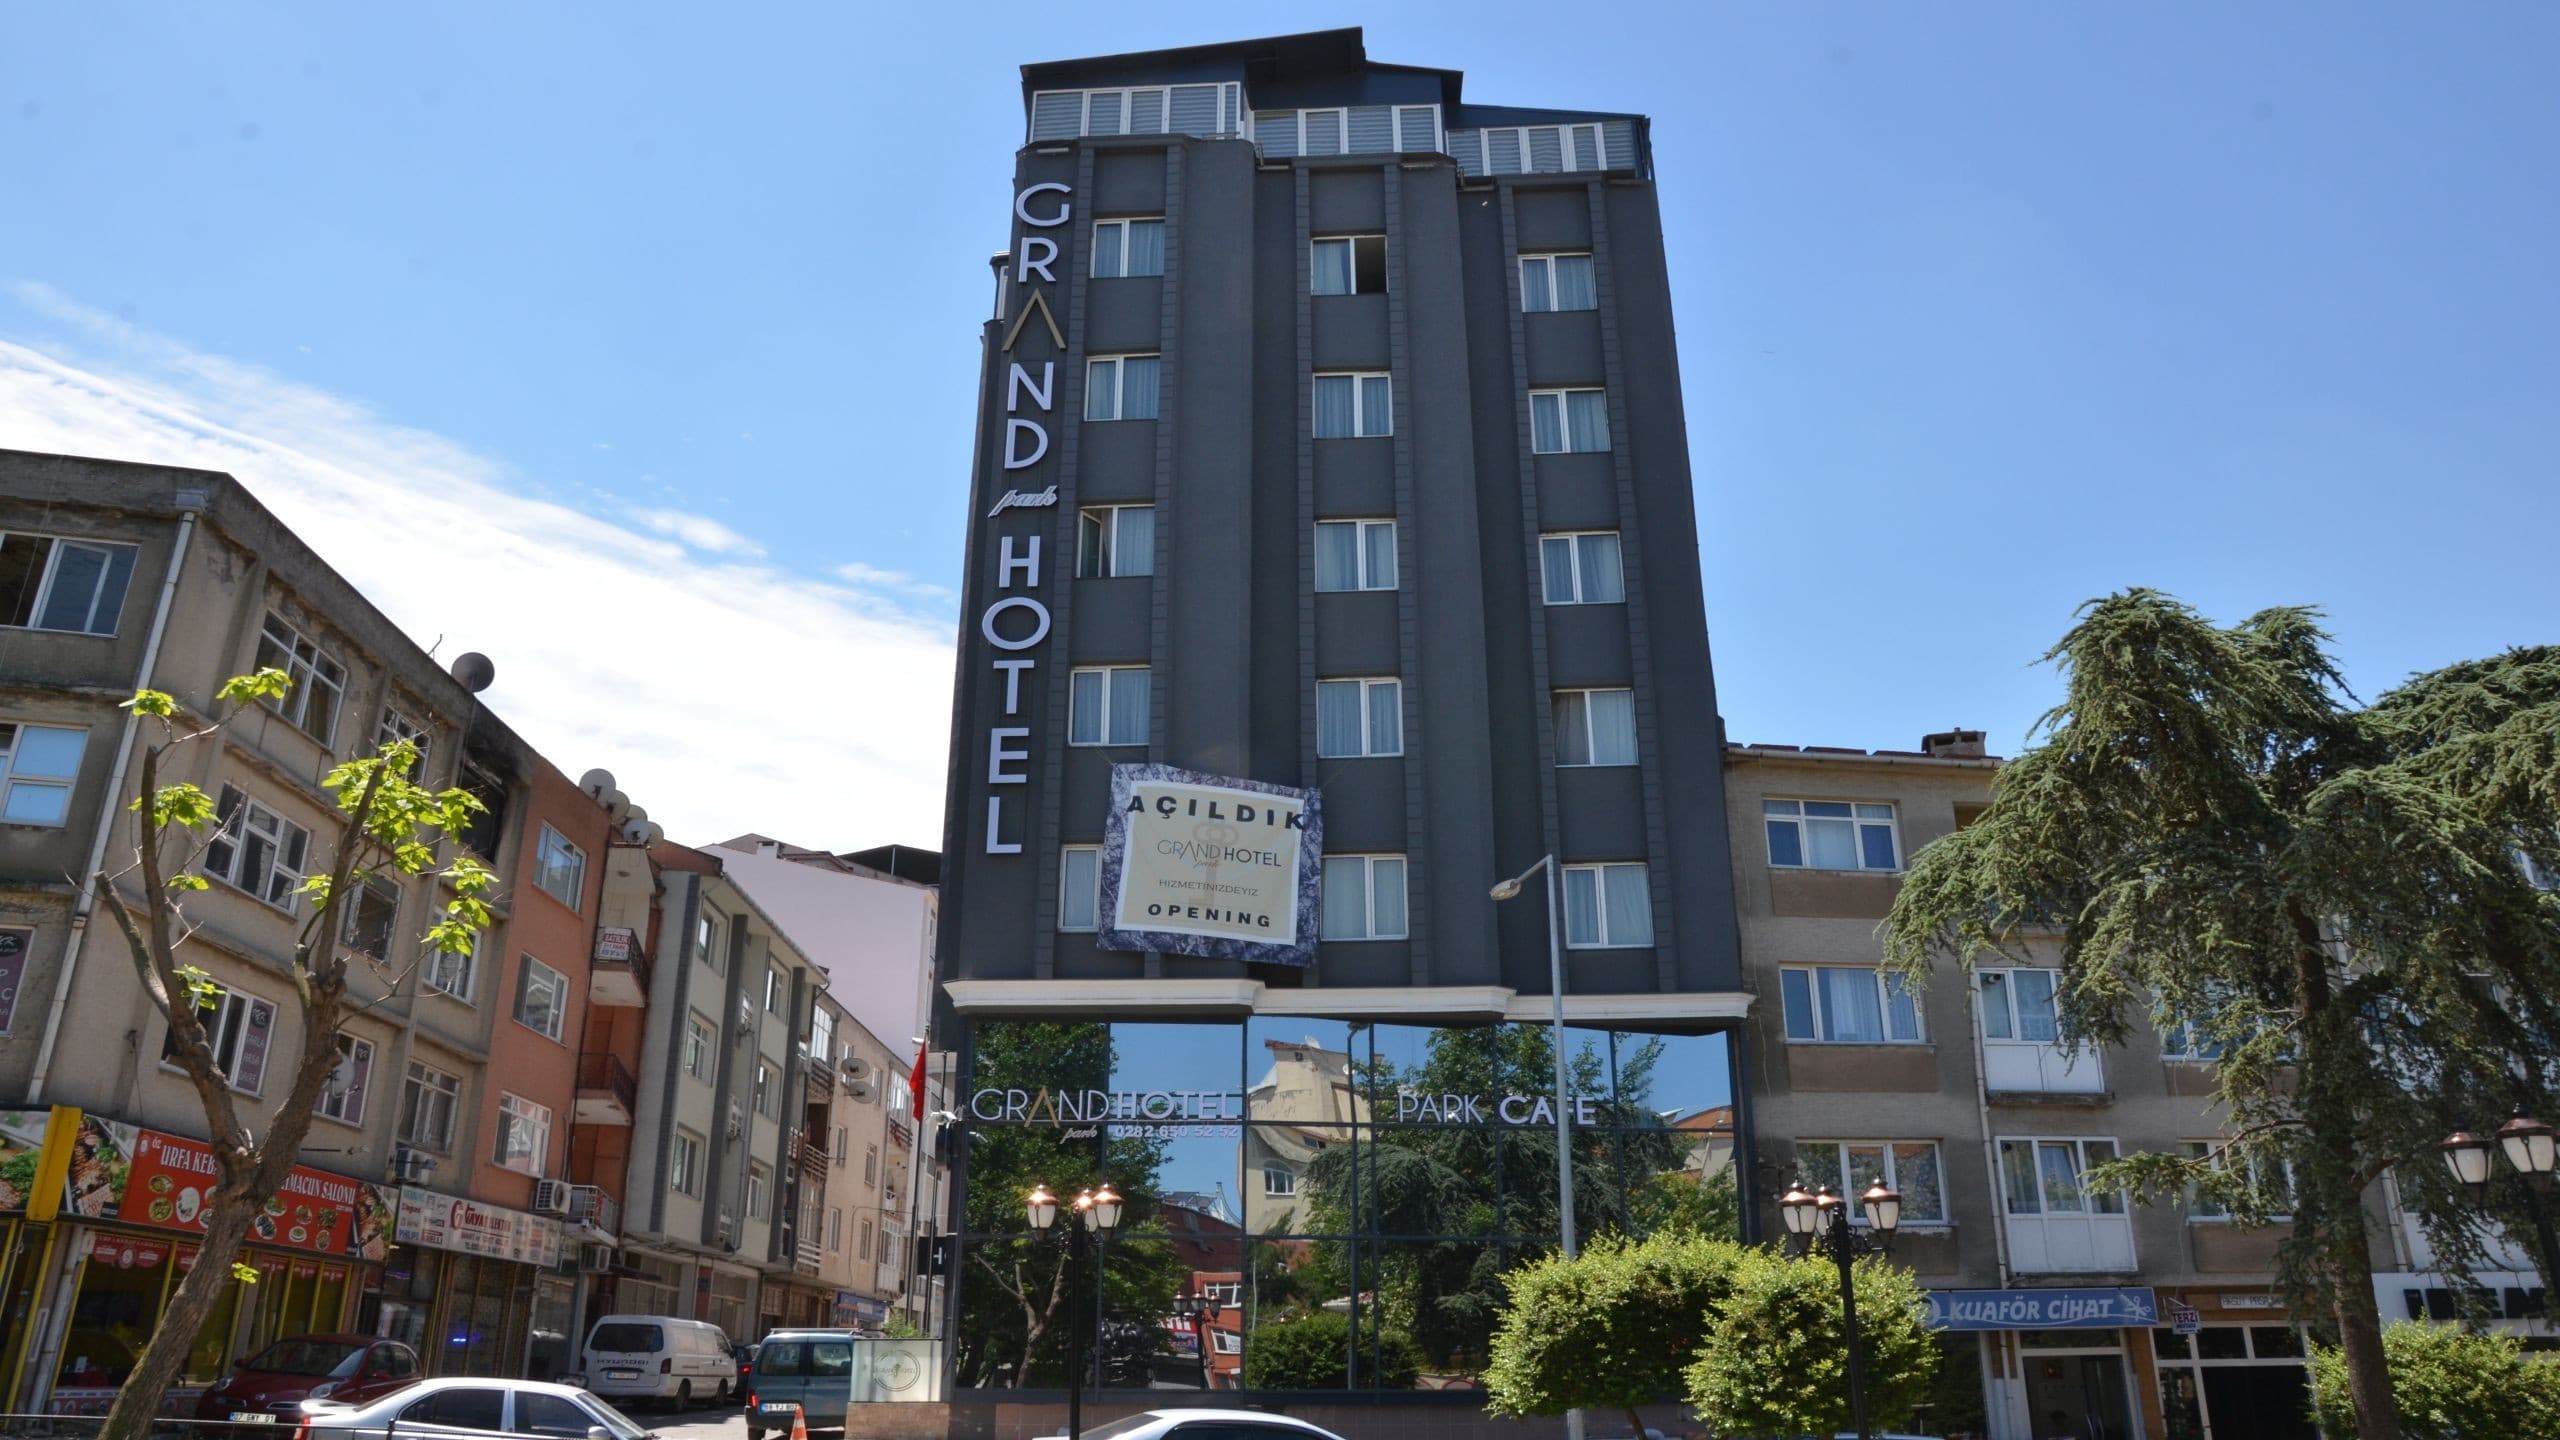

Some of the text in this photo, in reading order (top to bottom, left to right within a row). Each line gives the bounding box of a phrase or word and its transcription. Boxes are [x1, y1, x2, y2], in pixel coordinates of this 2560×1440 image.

[1001, 182, 1072, 469] GRAND
[982, 535, 1051, 854] HOTEL
[1127, 795, 1305, 831] AÇILDIK
[1157, 839, 1282, 867] GRAND HOTEL
[1148, 903, 1270, 928] OPENING
[971, 1087, 1238, 1128] GRAND HOTEL
[1399, 1094, 1484, 1124] PARK
[1060, 1124, 1098, 1144] park
[1116, 1126, 1153, 1138] 0282
[1159, 1126, 1188, 1138] 650
[160, 1145, 191, 1170] URFA
[192, 1152, 218, 1175] KEB
[1950, 1294, 2114, 1321] KUAFÖR CİHAT
